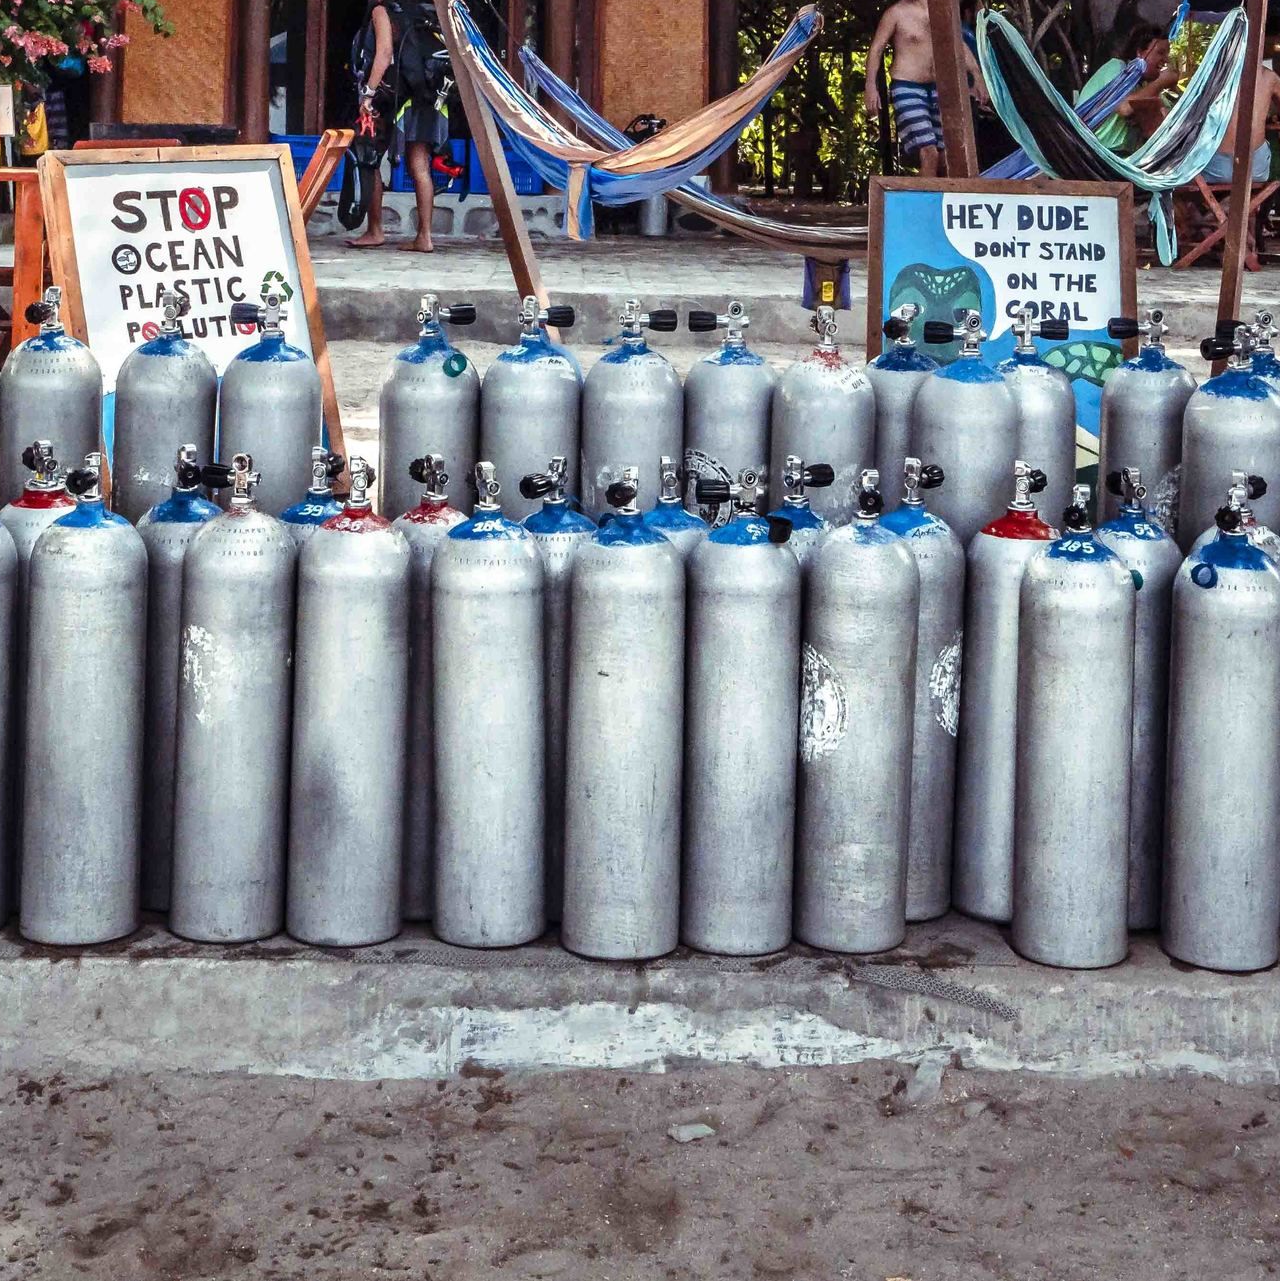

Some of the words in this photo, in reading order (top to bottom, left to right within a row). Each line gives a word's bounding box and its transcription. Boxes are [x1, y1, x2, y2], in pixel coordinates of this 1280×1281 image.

[110, 186, 240, 234] STOP
[946, 203, 1003, 230] HEY
[1017, 205, 1089, 231] DUDE
[111, 235, 244, 275] OCEAN
[974, 236, 1030, 259] DON'T
[1039, 242, 1106, 261] STAND
[119, 276, 247, 311] PLASTIC
[1007, 272, 1037, 290] ON
[1049, 273, 1097, 293] THE
[1005, 300, 1088, 321] CORAL
[1058, 540, 1095, 554] 185
